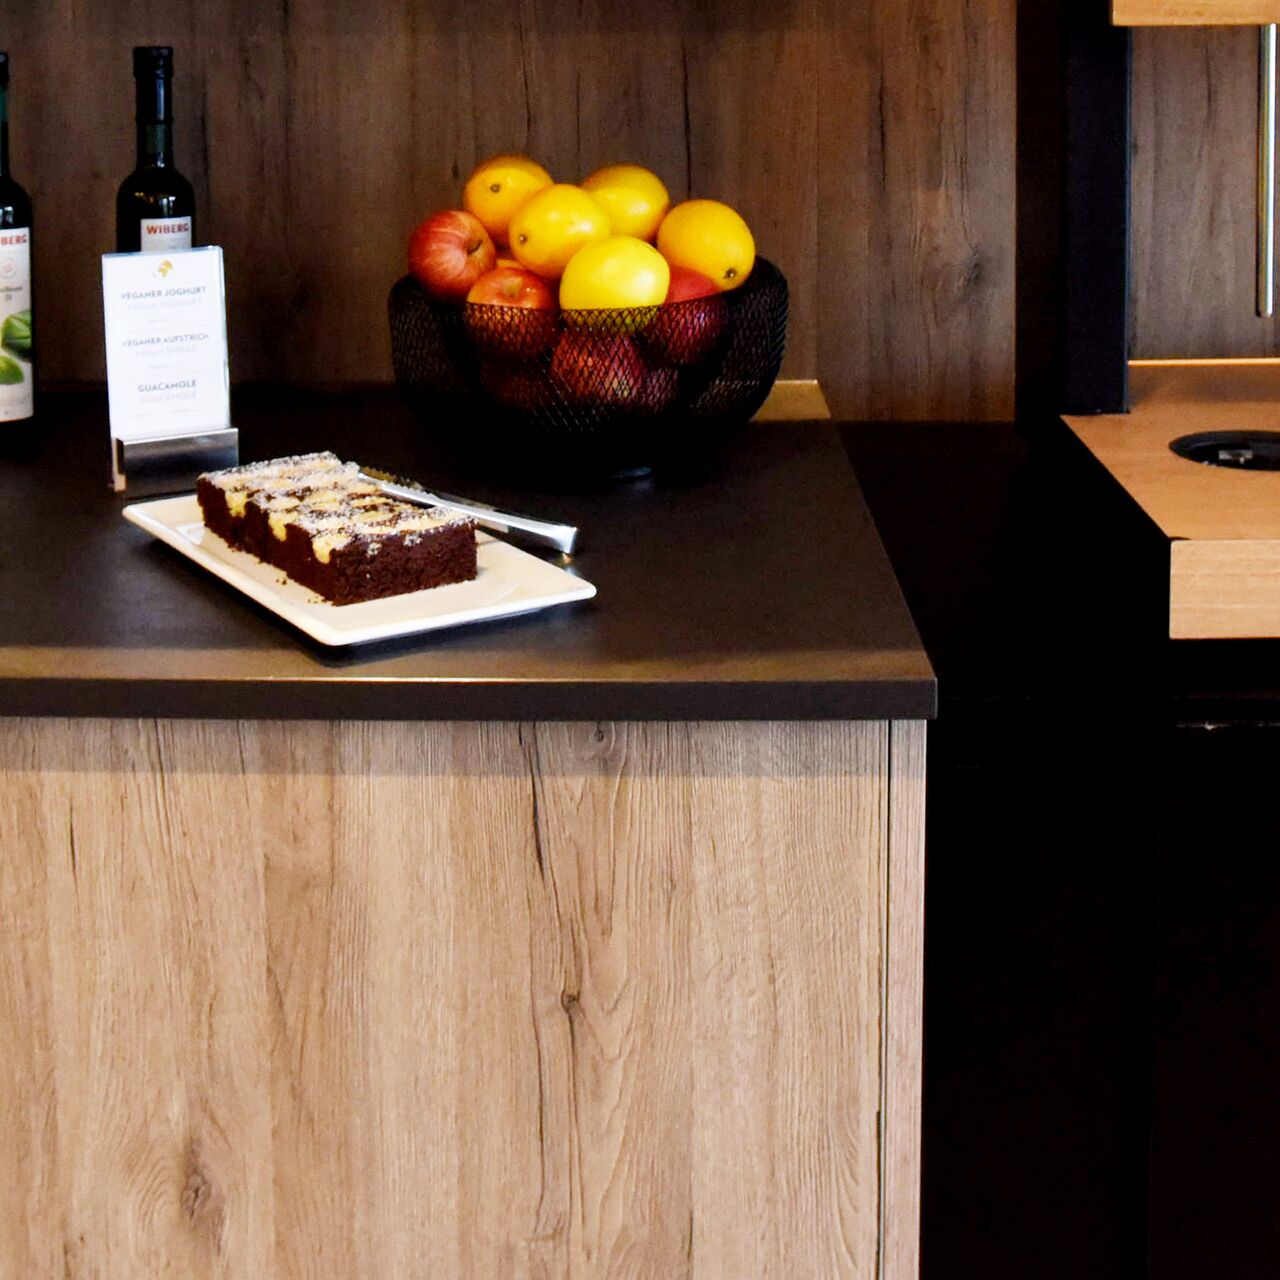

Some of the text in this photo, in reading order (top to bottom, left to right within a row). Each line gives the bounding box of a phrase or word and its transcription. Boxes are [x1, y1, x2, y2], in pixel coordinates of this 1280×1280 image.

[145, 222, 190, 235] WIBERG
[120, 285, 207, 300] VEGANER JOGHURT
[121, 332, 210, 347] VEGANER AUFSTRICH
[137, 379, 197, 392] GUACAMOLE
